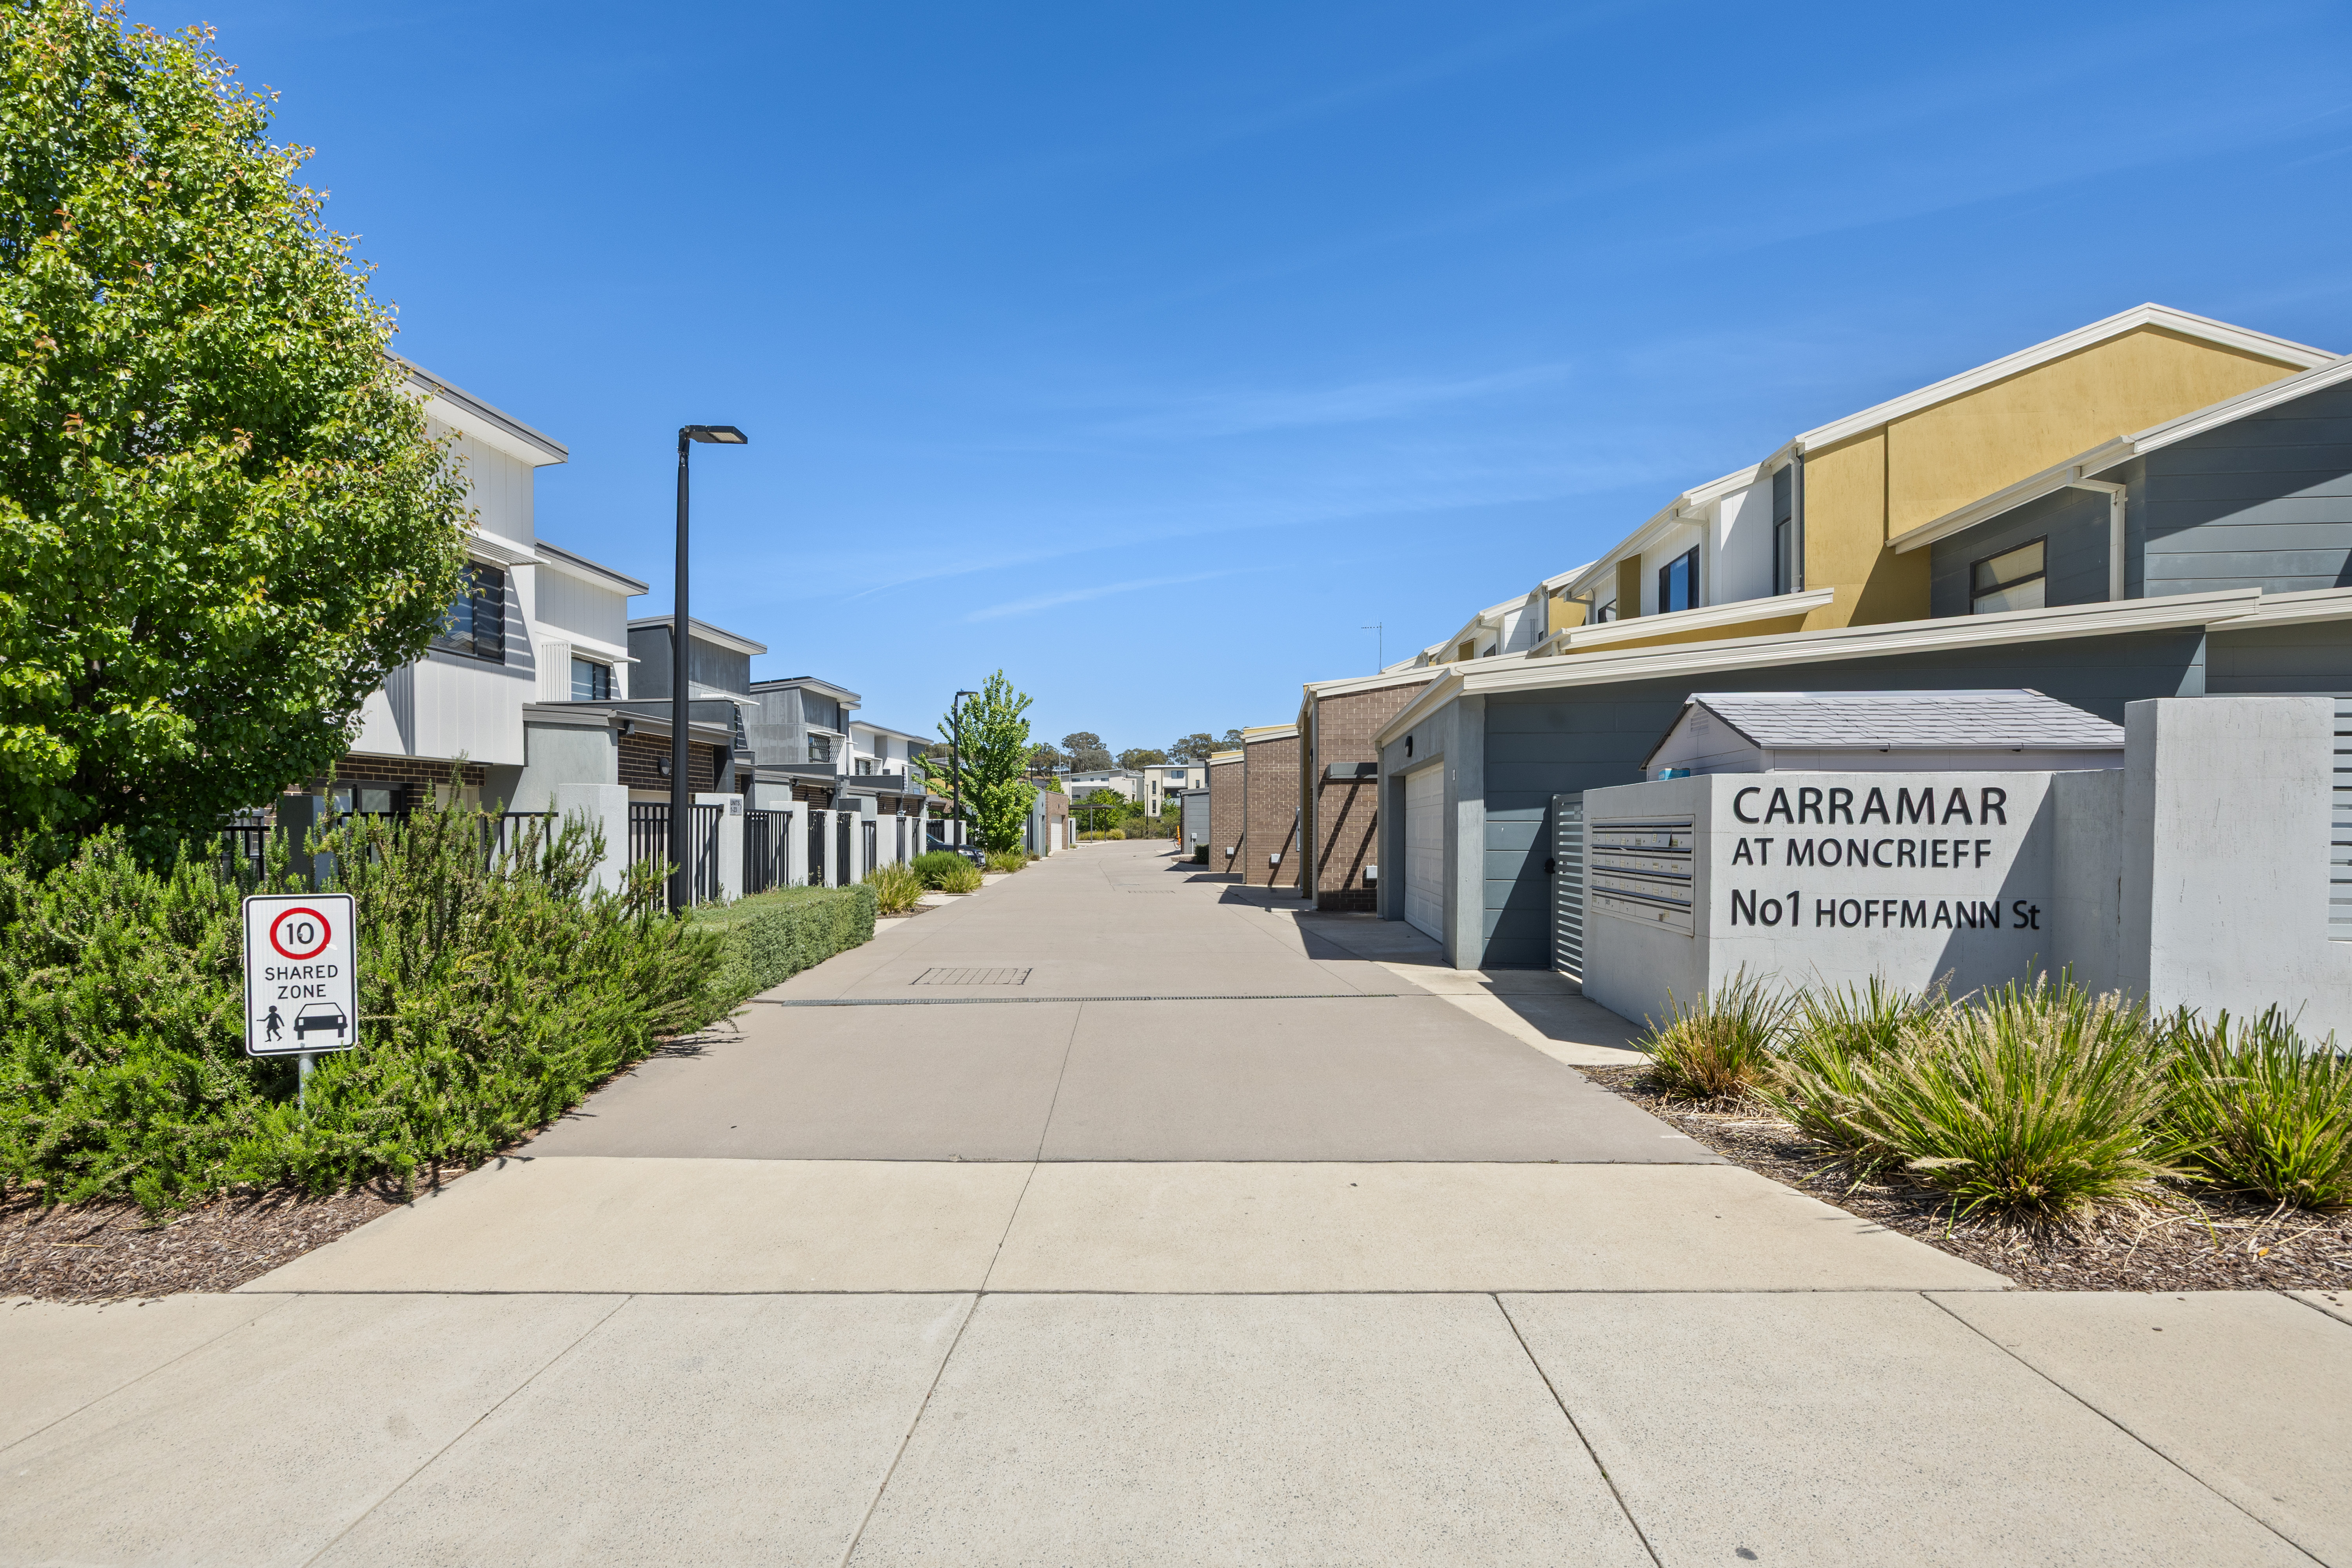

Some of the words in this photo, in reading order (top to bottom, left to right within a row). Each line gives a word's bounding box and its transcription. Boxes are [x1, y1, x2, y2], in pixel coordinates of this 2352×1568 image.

[1733, 786, 2007, 825] CARRAMAR
[1732, 837, 1774, 865] AT
[1786, 838, 1991, 868] MONCRIEFF
[1731, 889, 1800, 926] No1
[1816, 899, 2000, 929] HOFFMANN
[2013, 900, 2040, 930] St
[287, 922, 314, 945] 10
[265, 965, 338, 981] SHARED
[278, 984, 326, 999] ZONE
